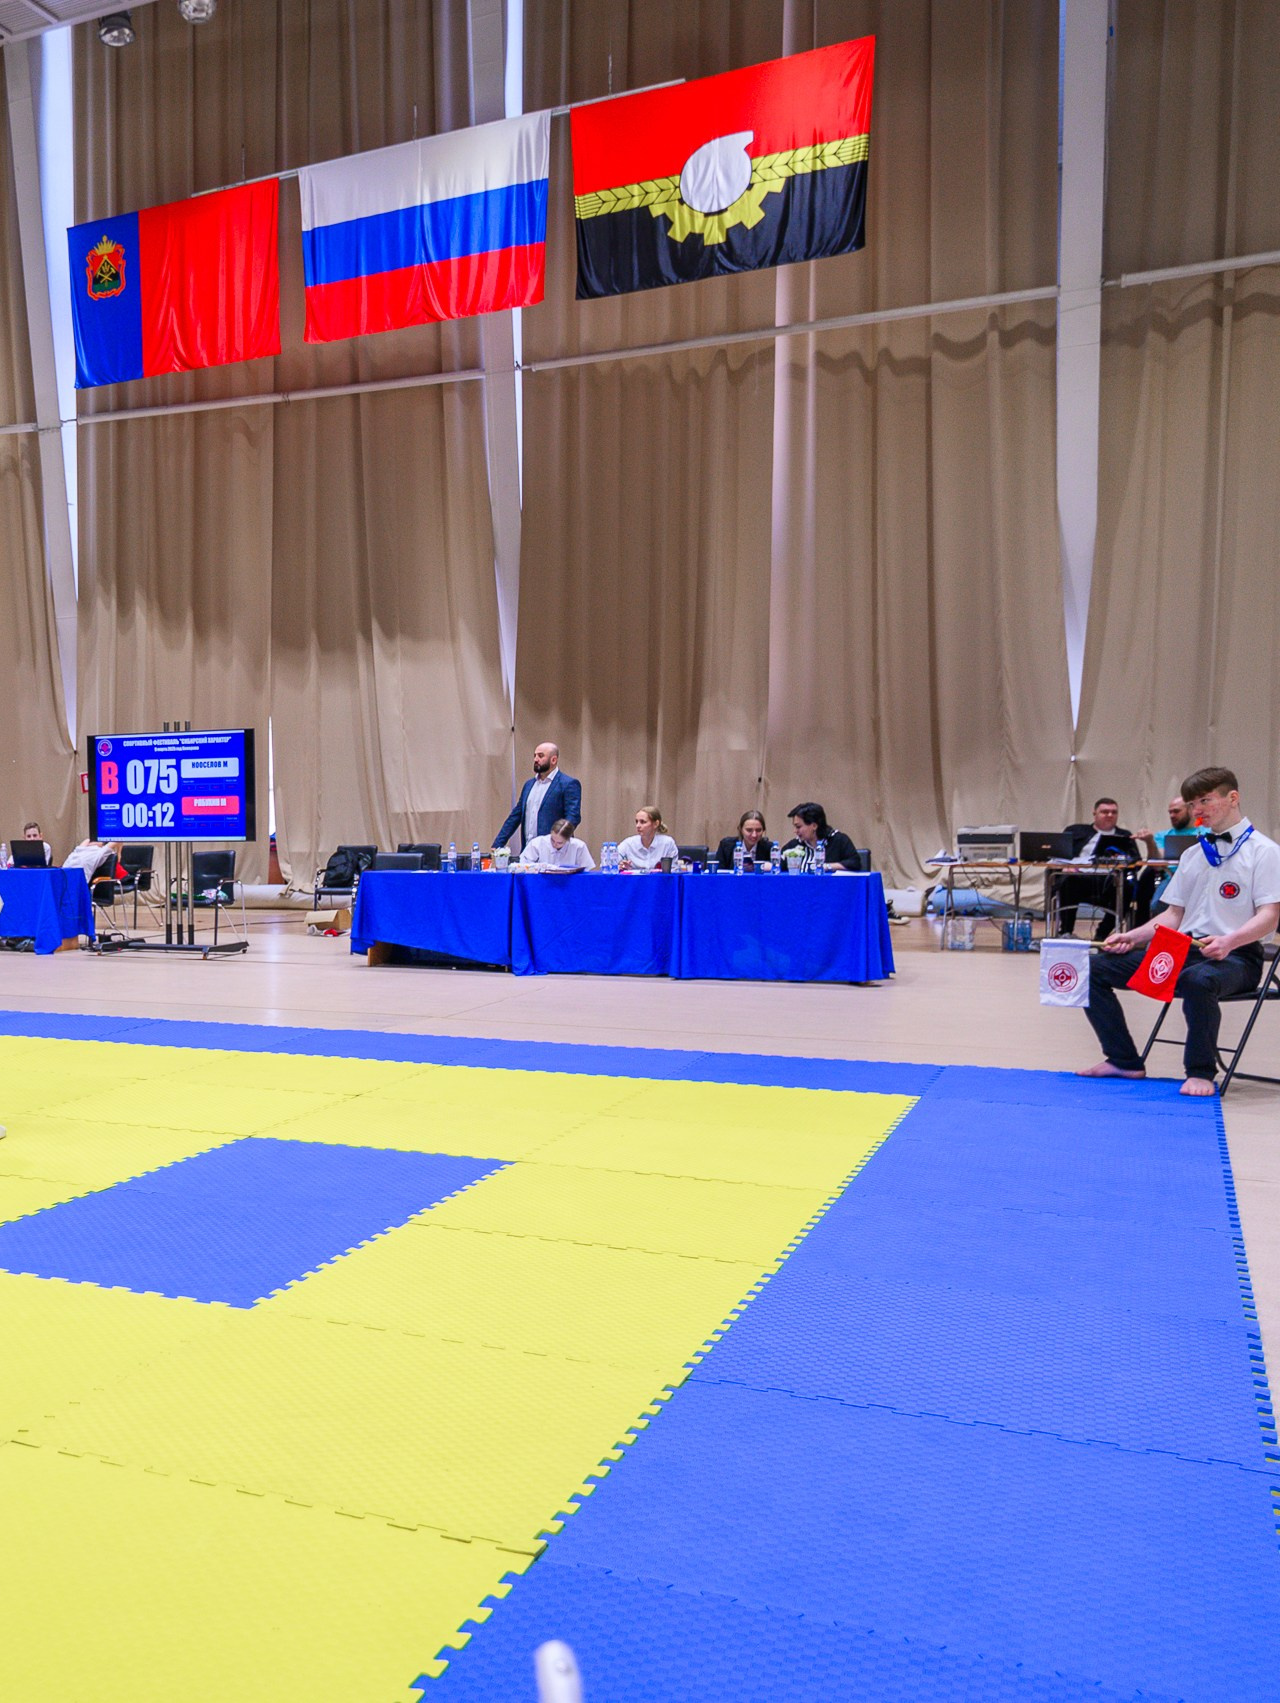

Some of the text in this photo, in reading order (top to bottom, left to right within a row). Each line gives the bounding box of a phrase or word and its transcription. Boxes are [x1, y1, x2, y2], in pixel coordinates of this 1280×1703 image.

[101, 758, 178, 795] B 075
[121, 802, 175, 828] 00:12
